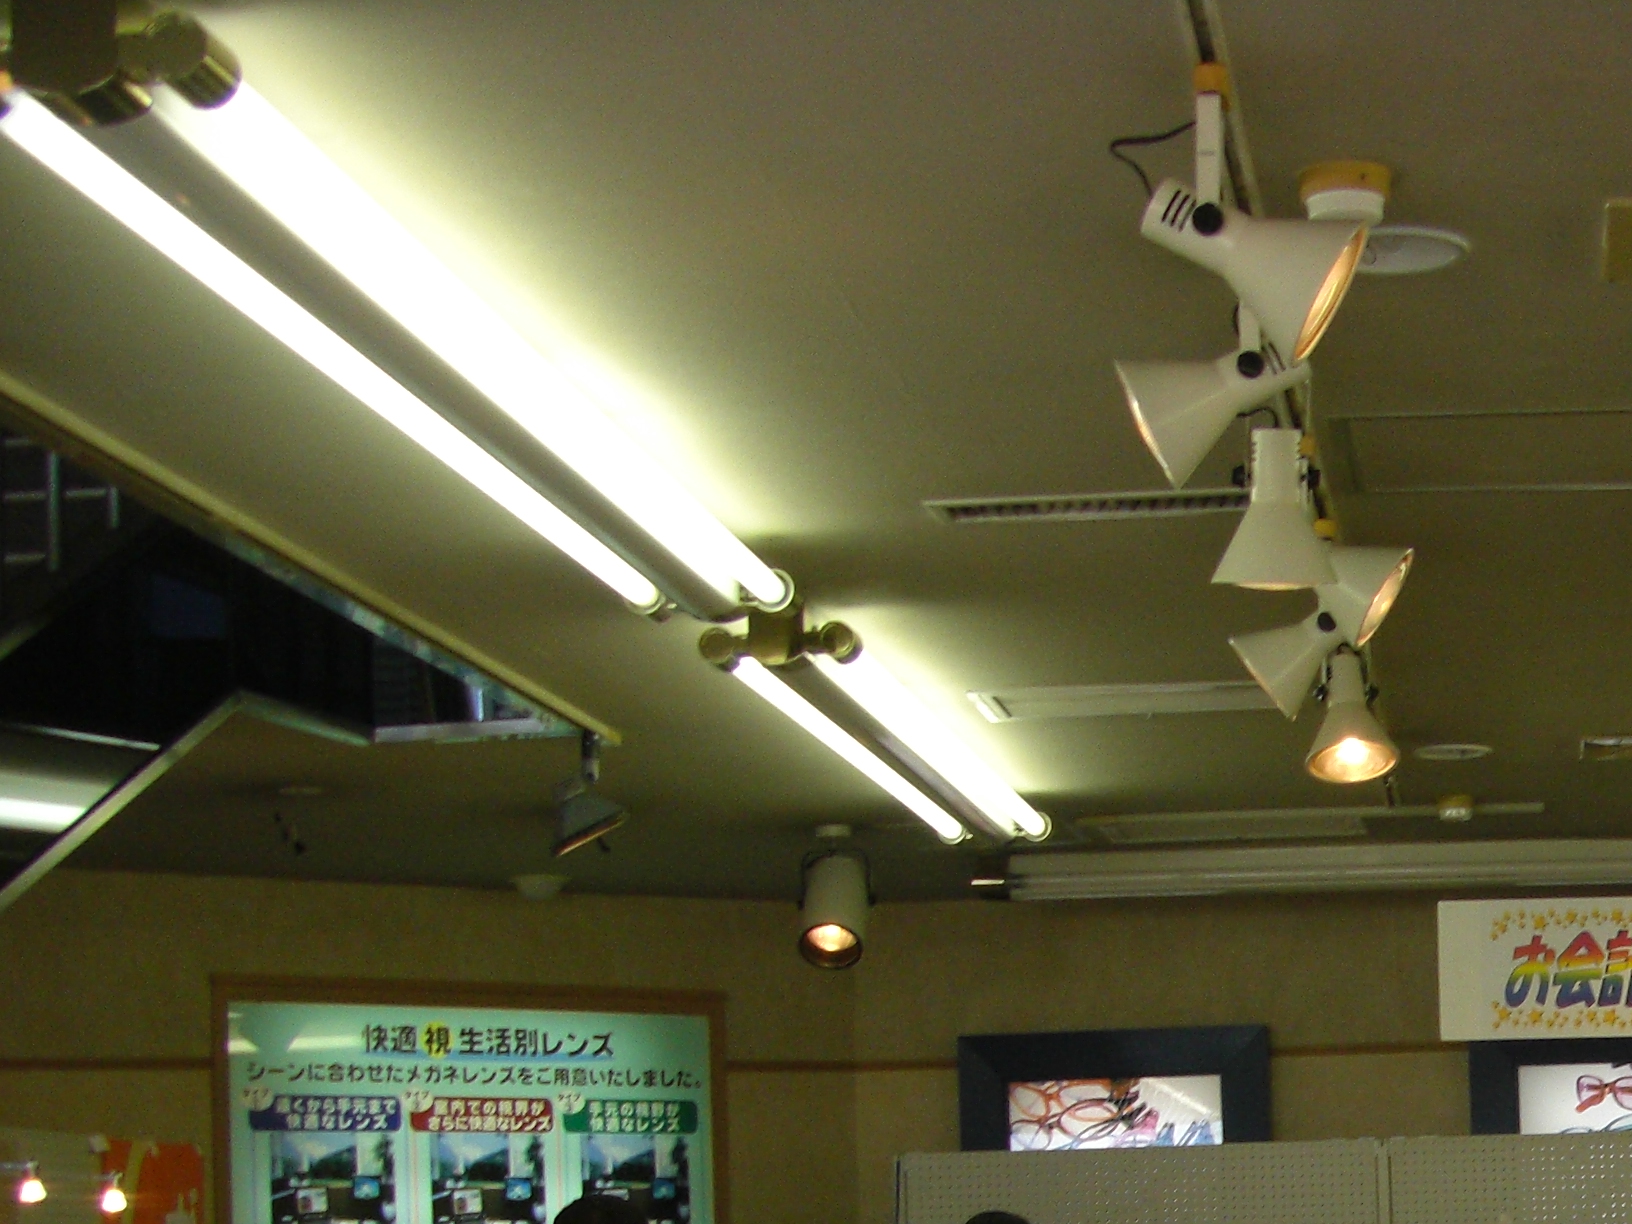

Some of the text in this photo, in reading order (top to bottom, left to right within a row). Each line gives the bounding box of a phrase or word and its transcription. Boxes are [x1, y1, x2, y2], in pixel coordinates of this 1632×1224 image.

[362, 1023, 613, 1058] 快適 視 生活別レンズ
[247, 1062, 702, 1090] シーンに合わせたメガネレンズをご用意いたしました。
[286, 1113, 389, 1131] 快適なレンズ
[428, 1115, 552, 1132] さらに快適なレンズ
[590, 1116, 681, 1133] 快適なレンズ
